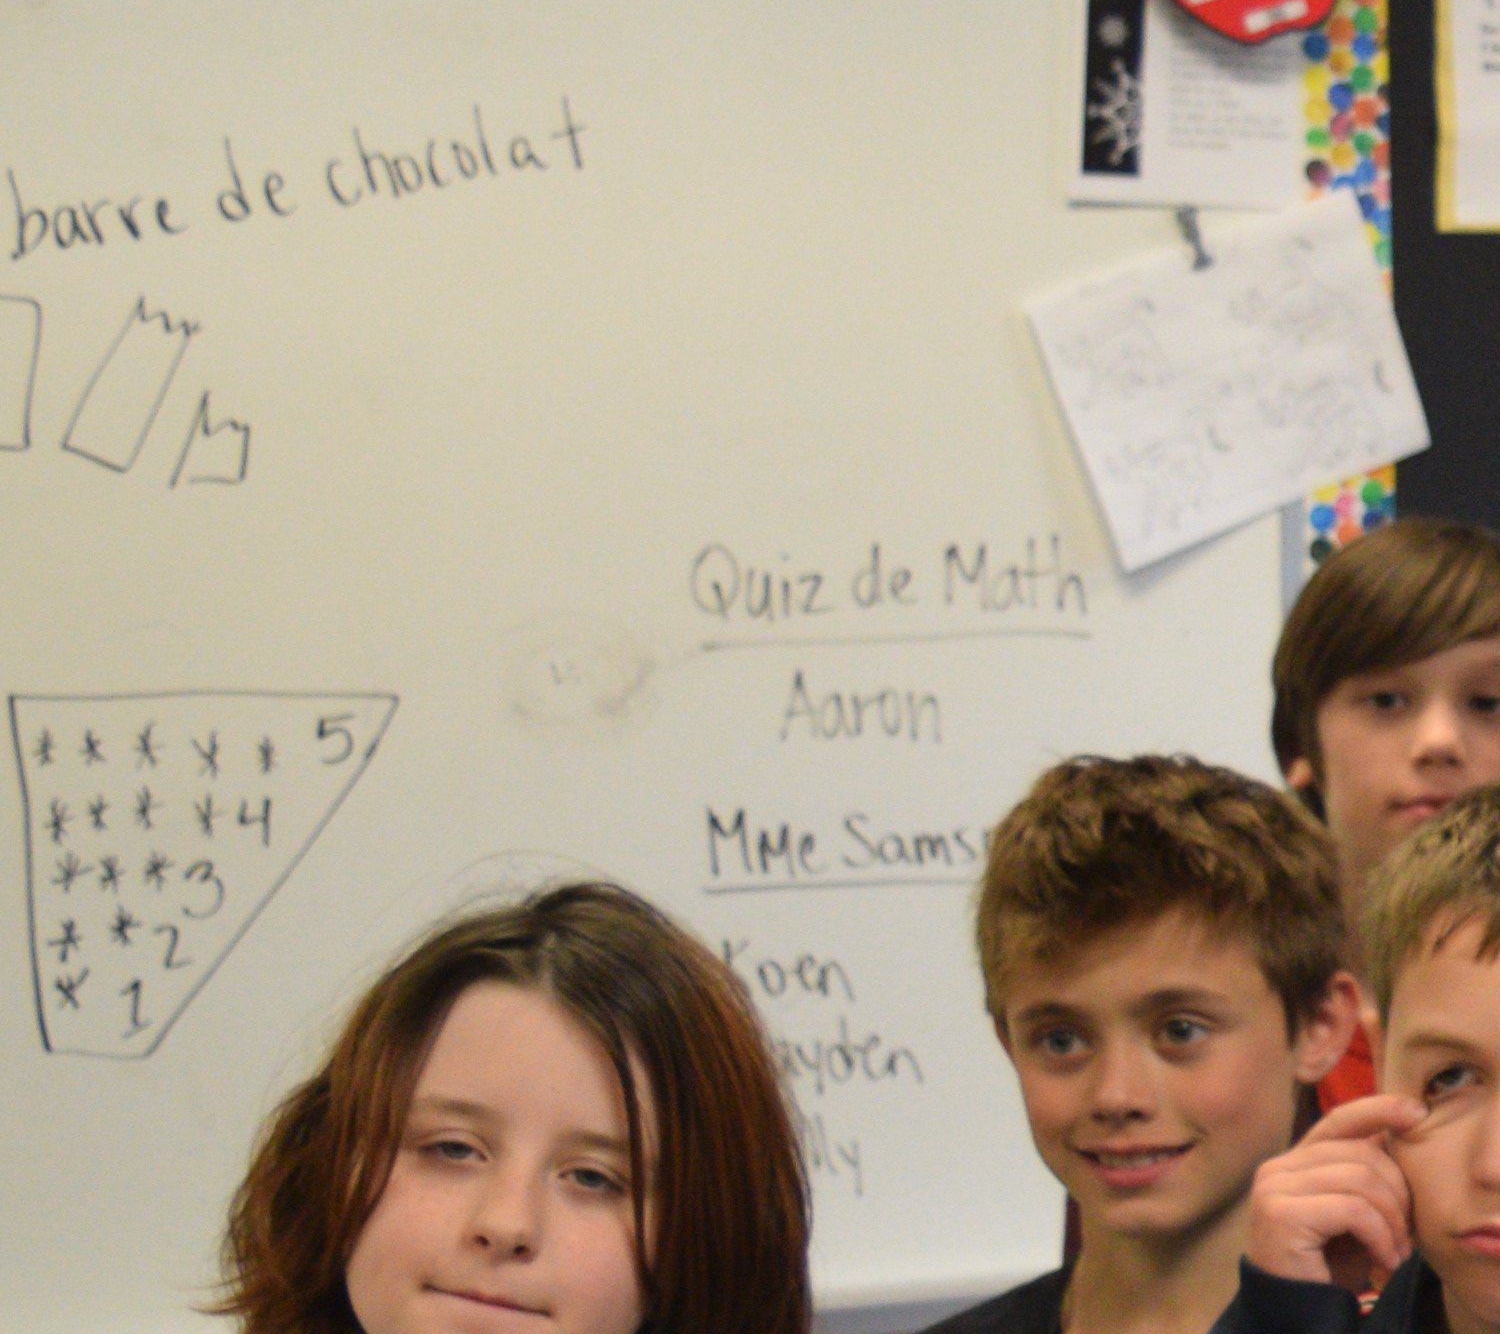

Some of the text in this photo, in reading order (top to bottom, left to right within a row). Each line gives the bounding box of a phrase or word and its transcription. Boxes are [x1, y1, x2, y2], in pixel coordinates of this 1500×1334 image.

[7, 95, 586, 260] barre de chocolat
[692, 534, 1089, 620] Quiz de Math
[779, 670, 942, 743] Aaron
[316, 712, 355, 765] 5
[237, 797, 272, 847] 4
[844, 814, 988, 867] Sams
[182, 860, 225, 919] 3
[153, 923, 192, 969] 2
[119, 979, 151, 1038] 1
